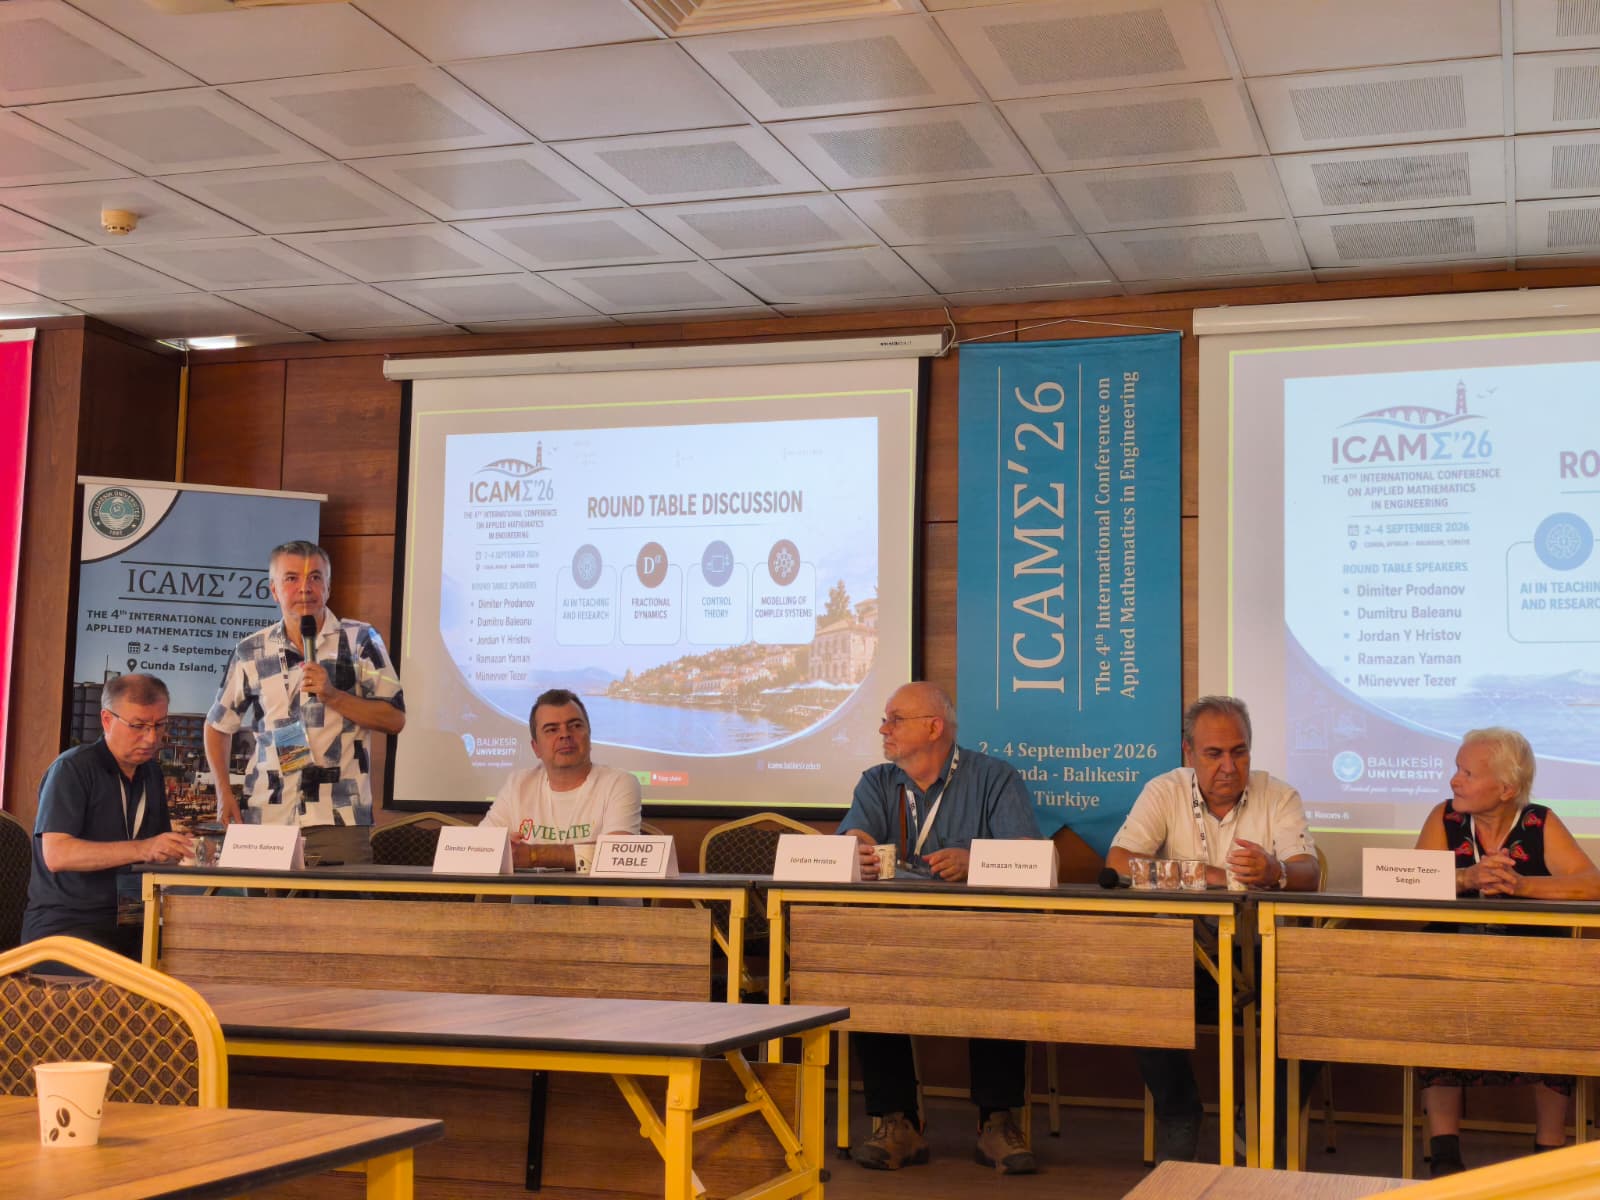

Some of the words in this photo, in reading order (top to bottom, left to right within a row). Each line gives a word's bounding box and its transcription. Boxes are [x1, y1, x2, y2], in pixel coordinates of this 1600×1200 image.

[1099, 377, 1111, 400] on
[1120, 371, 1139, 480] Engineering
[1095, 403, 1111, 505] Conference
[1322, 475, 1339, 484] THE
[1360, 471, 1434, 483] INTERNATIONAL
[1438, 468, 1500, 480] CONFERENCE
[1120, 486, 1136, 503] in
[1348, 488, 1361, 496] ON
[1364, 486, 1404, 496] APPLIED
[1406, 484, 1476, 494] MATHEMATICS
[587, 495, 644, 518] ROUND
[649, 493, 696, 517] TABLE
[702, 490, 803, 515] DISCUSSION
[1371, 500, 1382, 510] IN
[1384, 498, 1448, 510] ENGINEERING
[1386, 523, 1442, 534] SEPTEMBER
[1095, 510, 1111, 629] International
[1120, 508, 1136, 623] Mathematics
[1343, 564, 1380, 574] ROUND
[1382, 563, 1412, 573] TABLE
[1416, 562, 1468, 572] SPEAKERS
[1357, 584, 1402, 597] Dimiter
[1406, 583, 1465, 596] Prodanov
[1520, 582, 1532, 594] AI
[1535, 582, 1547, 594] IN
[632, 598, 670, 607] FRACTIONAL
[702, 596, 732, 606] CONTROL
[761, 596, 797, 605] MODELLING
[1521, 598, 1546, 610] AND
[87, 610, 108, 619] THE
[129, 612, 216, 625] INTERNATIONAL
[220, 616, 280, 627] CONFEREN
[634, 610, 668, 620] DYNAMICS
[704, 609, 728, 618] THEORY
[754, 609, 783, 618] COMPLEX
[785, 608, 812, 618] SYSTEMS
[1357, 607, 1407, 620] Dumitru
[1411, 606, 1462, 618] Baleanu
[86, 624, 132, 634] APPLIED
[136, 626, 212, 638] MATHEMATICS
[216, 629, 228, 639] IN
[1358, 630, 1400, 642] Jordan
[1404, 630, 1412, 641] Y
[1416, 628, 1462, 641] Hristov
[143, 643, 150, 652] 2
[162, 644, 168, 652] 4
[172, 644, 234, 656] September
[1095, 634, 1111, 656] 4th
[1120, 628, 1139, 699] Applied
[1358, 652, 1414, 664] Ramazan
[1419, 652, 1462, 664] Yaman
[140, 660, 176, 671] Cunda
[179, 662, 217, 674] Island,
[1095, 660, 1111, 696] The
[1358, 674, 1419, 688] Münevver
[1424, 674, 1456, 686] Tezer
[979, 742, 988, 755] 2
[1003, 742, 1014, 756] 4
[1018, 742, 1110, 762] September
[1114, 743, 1158, 759] 2026
[1016, 765, 1048, 781] nda
[1368, 770, 1444, 780] UNIVERSITY
[1034, 790, 1100, 810] Türkiye
[612, 844, 653, 853] ROUND
[612, 857, 648, 866] TABLE
[1014, 862, 1038, 870] Yaman
[1376, 864, 1416, 872] Münevver
[1395, 876, 1421, 884] Sezgin
